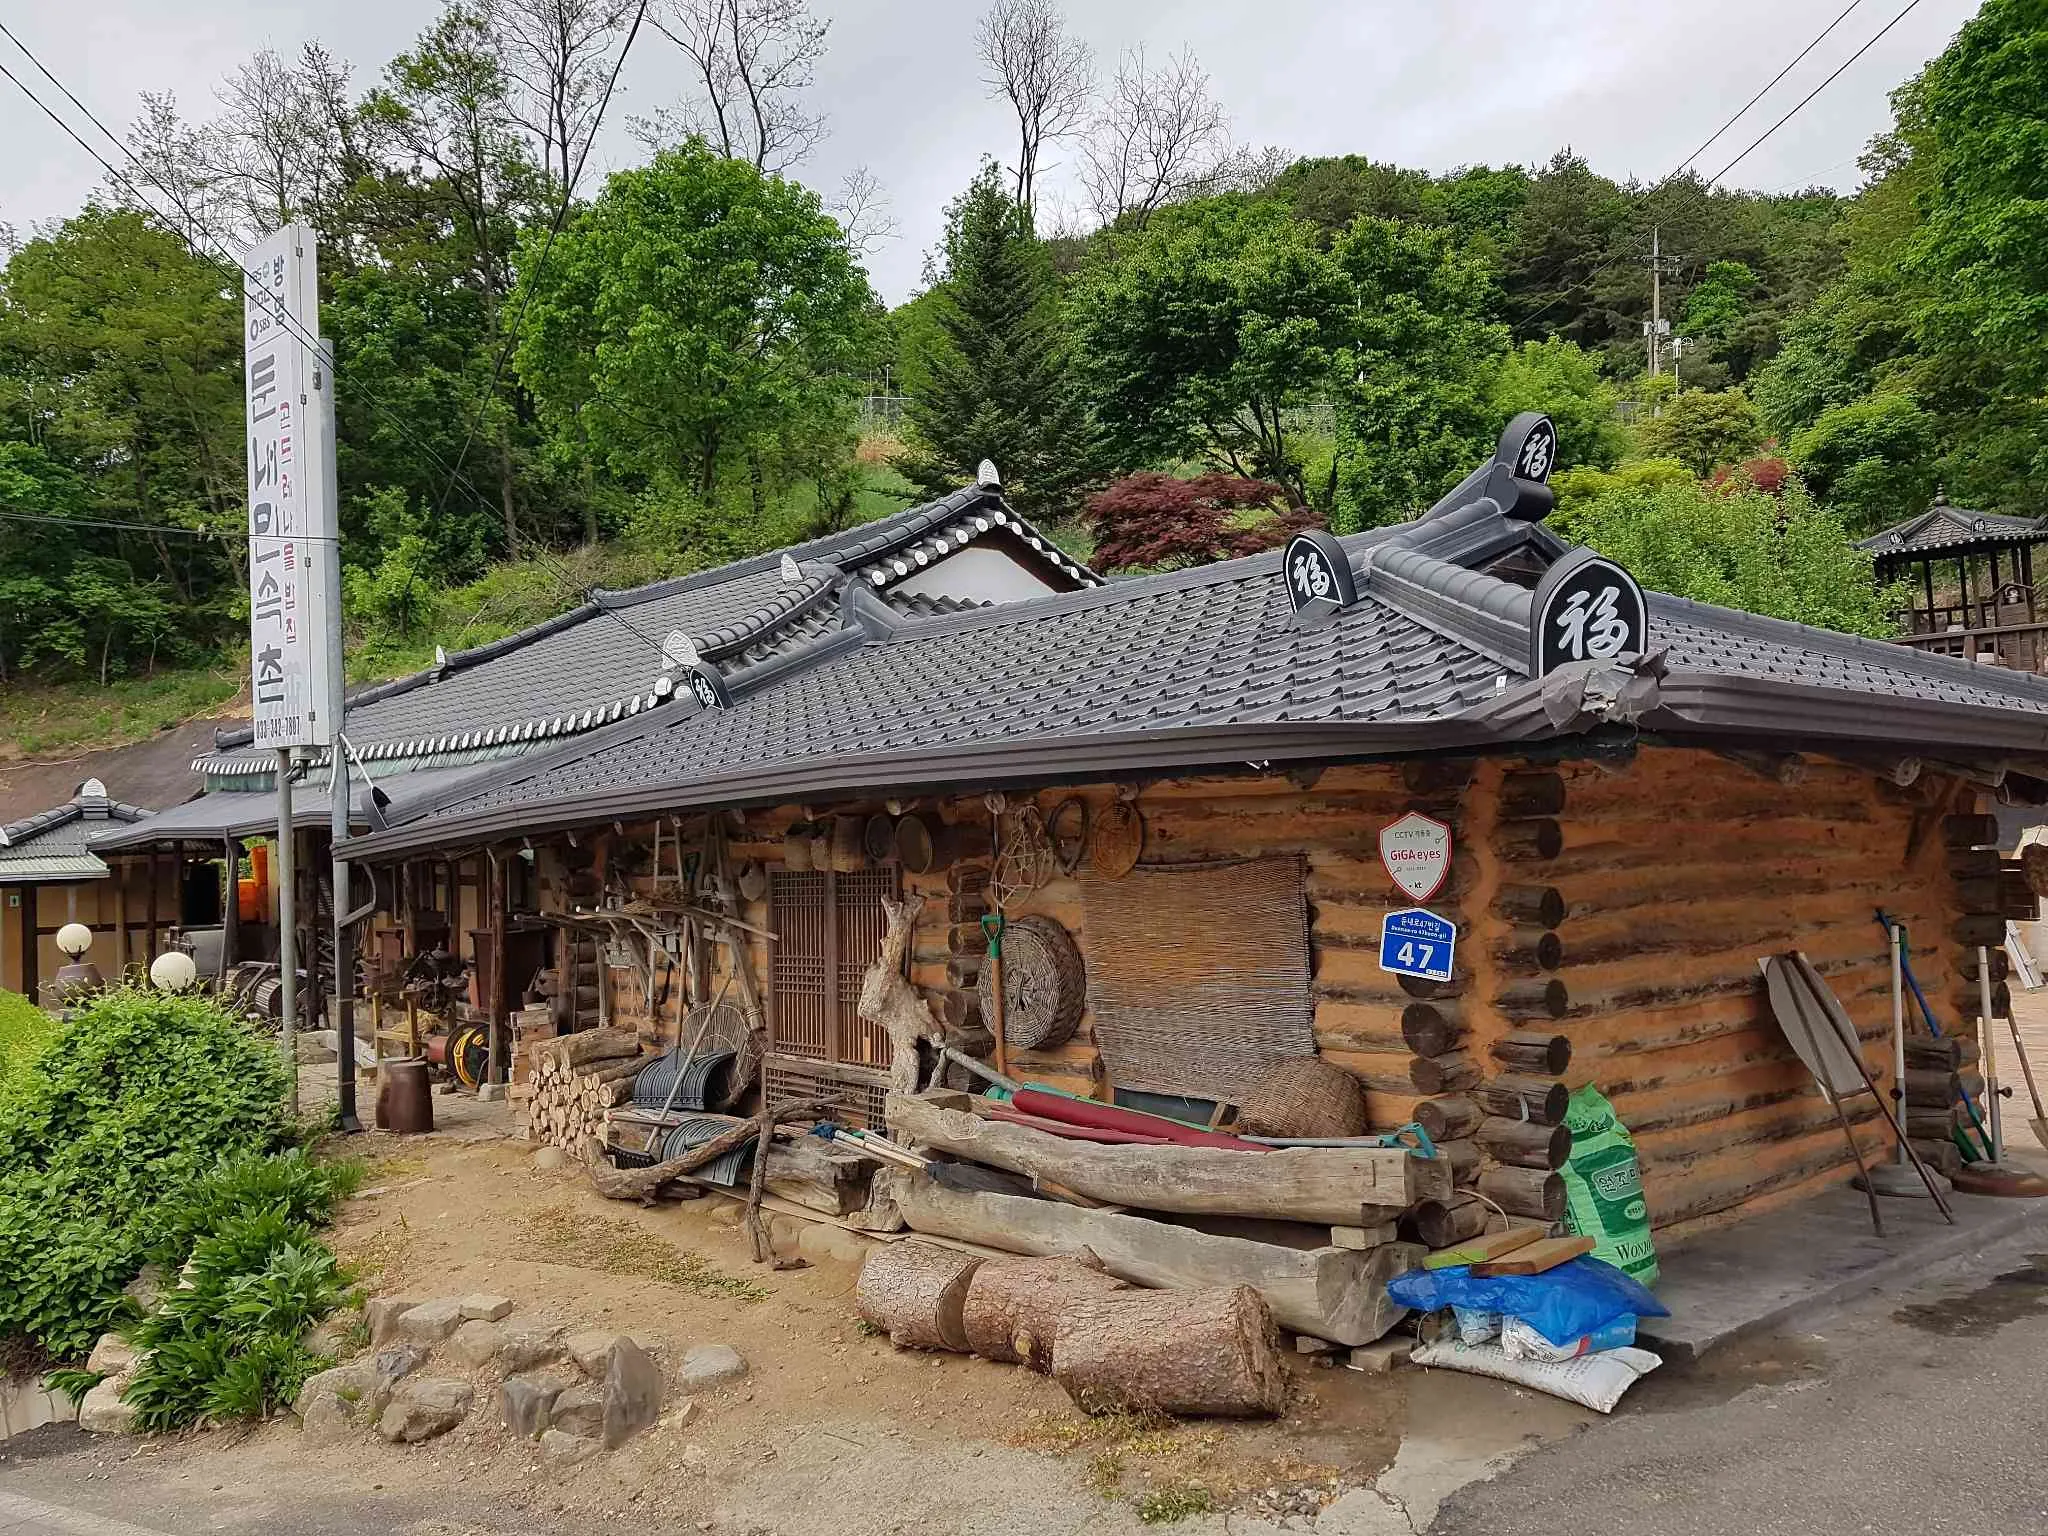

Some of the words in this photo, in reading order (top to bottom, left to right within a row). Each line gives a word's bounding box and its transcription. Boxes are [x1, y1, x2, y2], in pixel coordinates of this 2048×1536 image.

[259, 316, 271, 333] SBS
[1522, 432, 1551, 478] 福
[251, 353, 284, 705] 둔내민속촌
[1293, 552, 1330, 597] 福
[1557, 586, 1630, 660] 福
[1394, 831, 1414, 839] CCTV
[1397, 941, 1434, 969] 47
